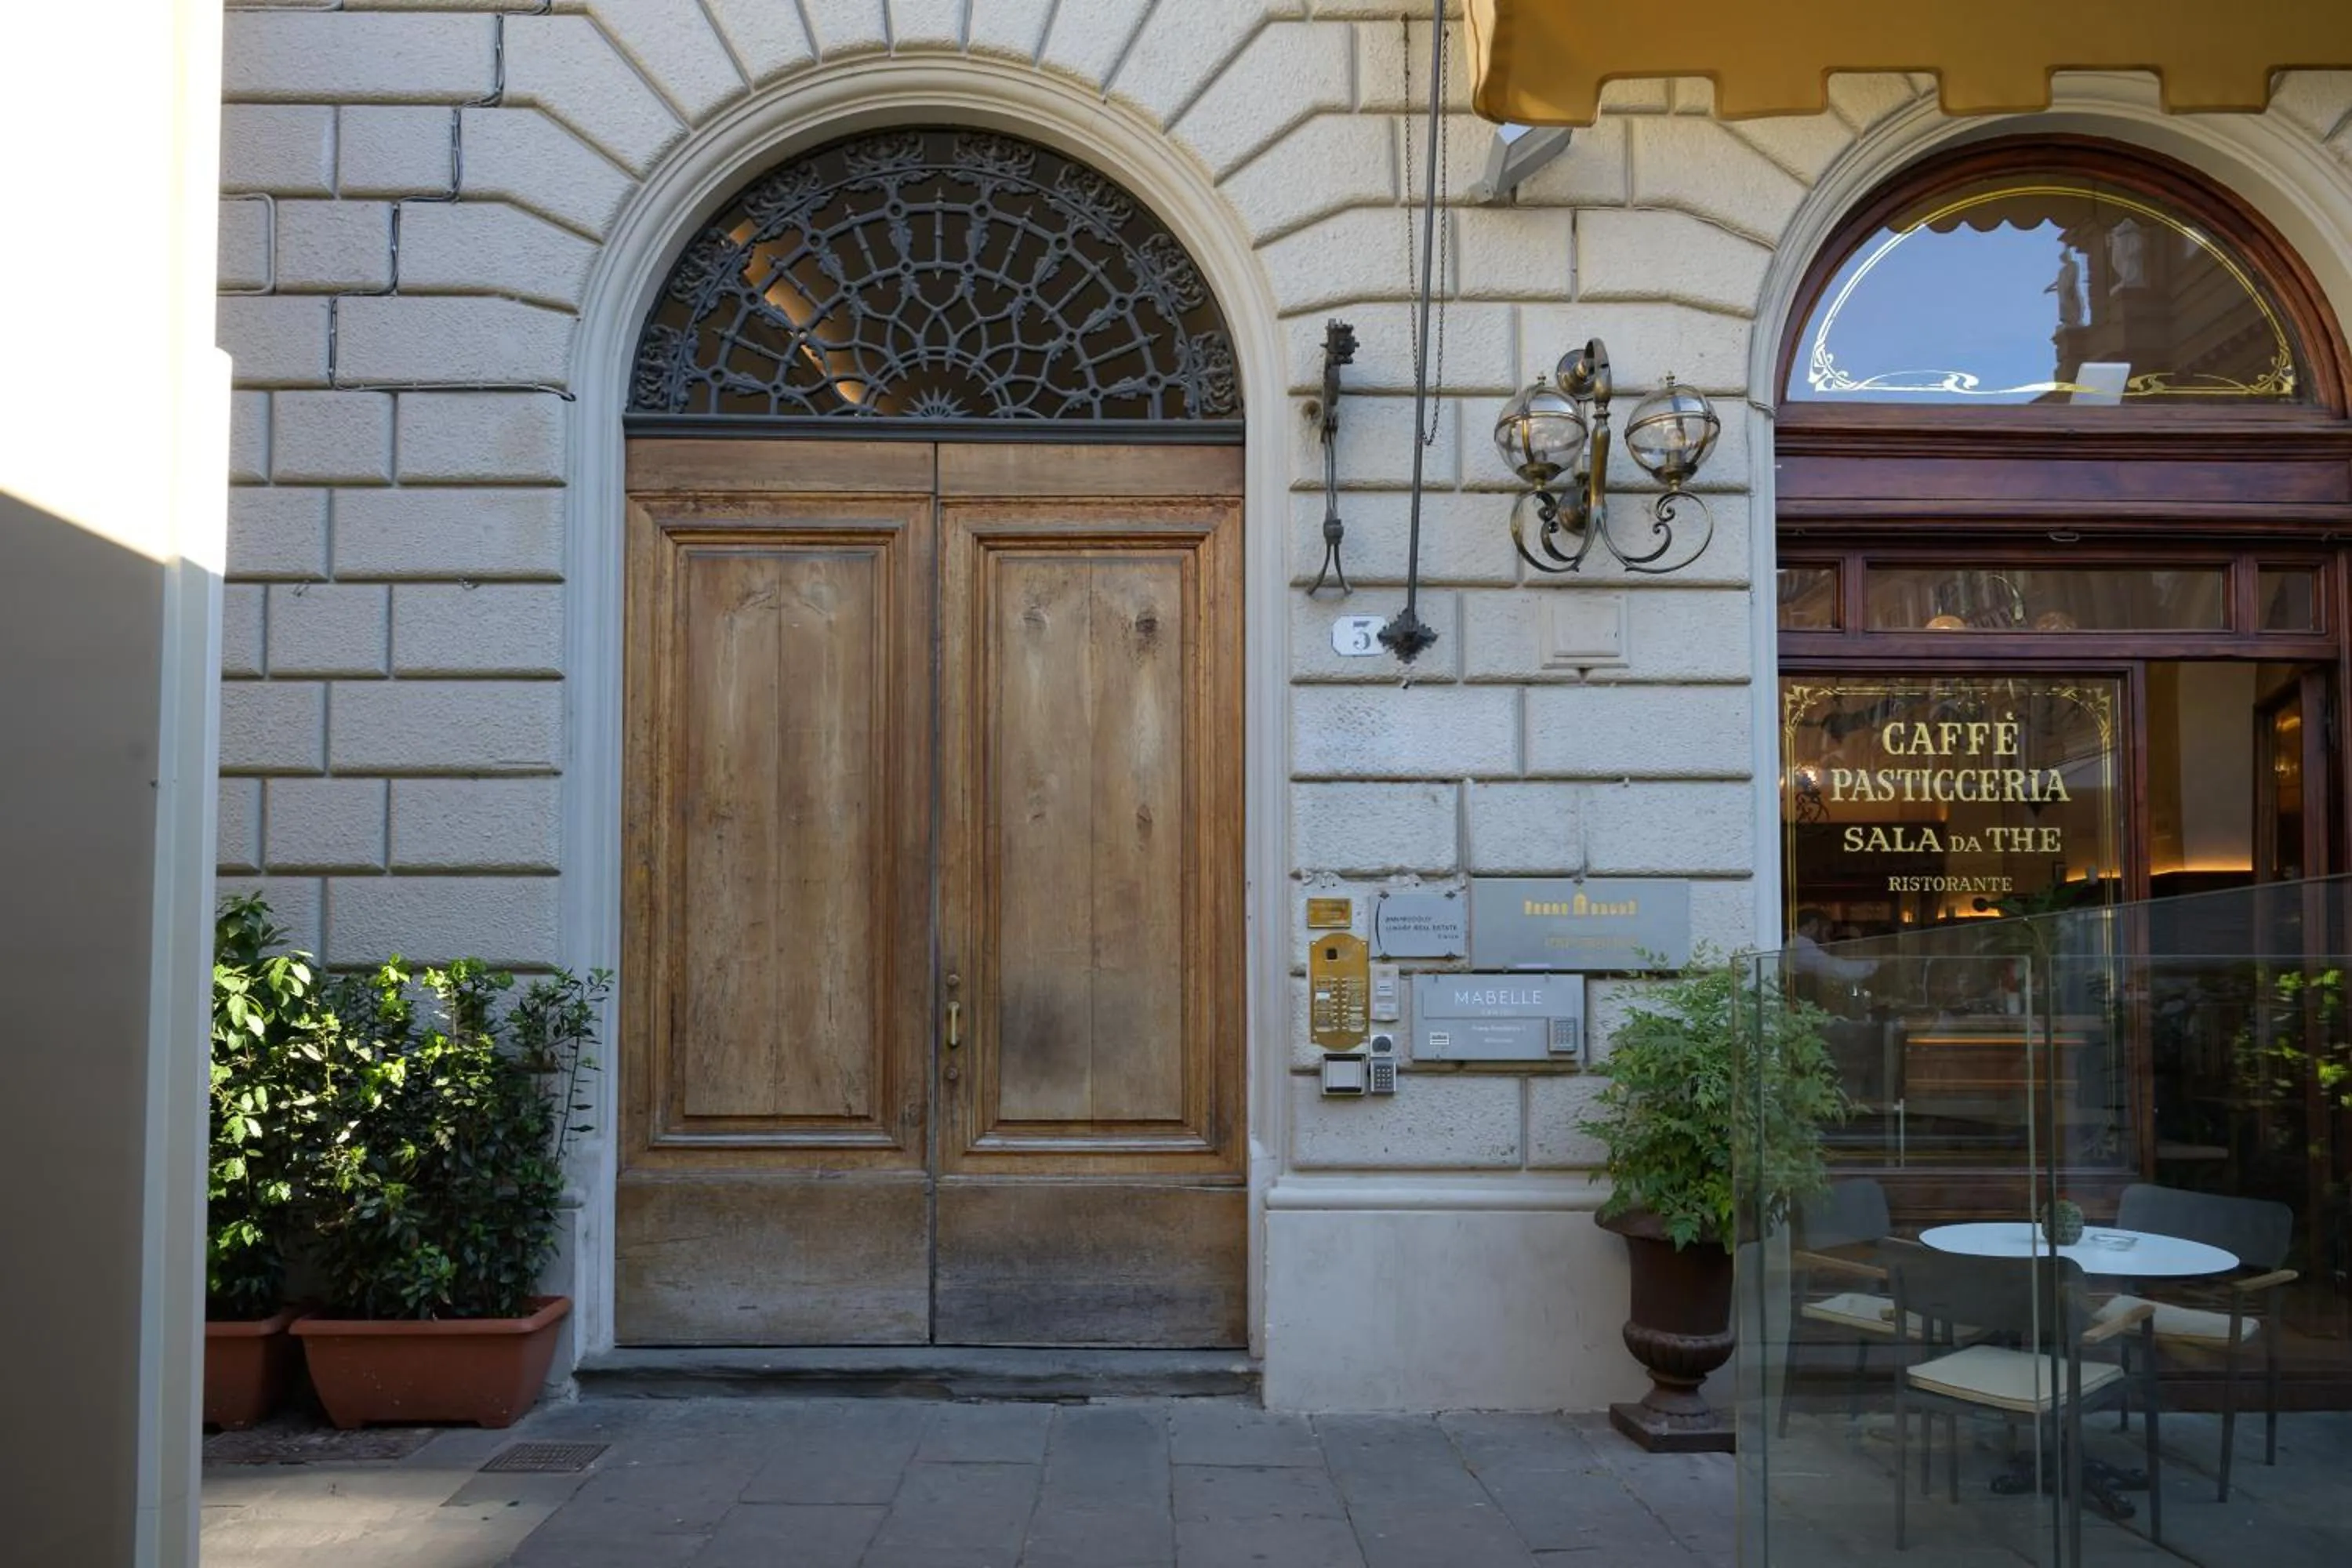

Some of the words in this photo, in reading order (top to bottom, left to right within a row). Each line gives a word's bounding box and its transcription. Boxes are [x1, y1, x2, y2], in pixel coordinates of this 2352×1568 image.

[1882, 711, 2019, 755] CAFFÈ
[1830, 768, 2071, 802] PASTICCERIA
[1843, 826, 1944, 853] SALA
[1950, 835, 1983, 852] DA
[1986, 826, 2061, 853] THE
[1888, 876, 2013, 891] RISTORANTE
[1454, 989, 1543, 1005] MABELLE
